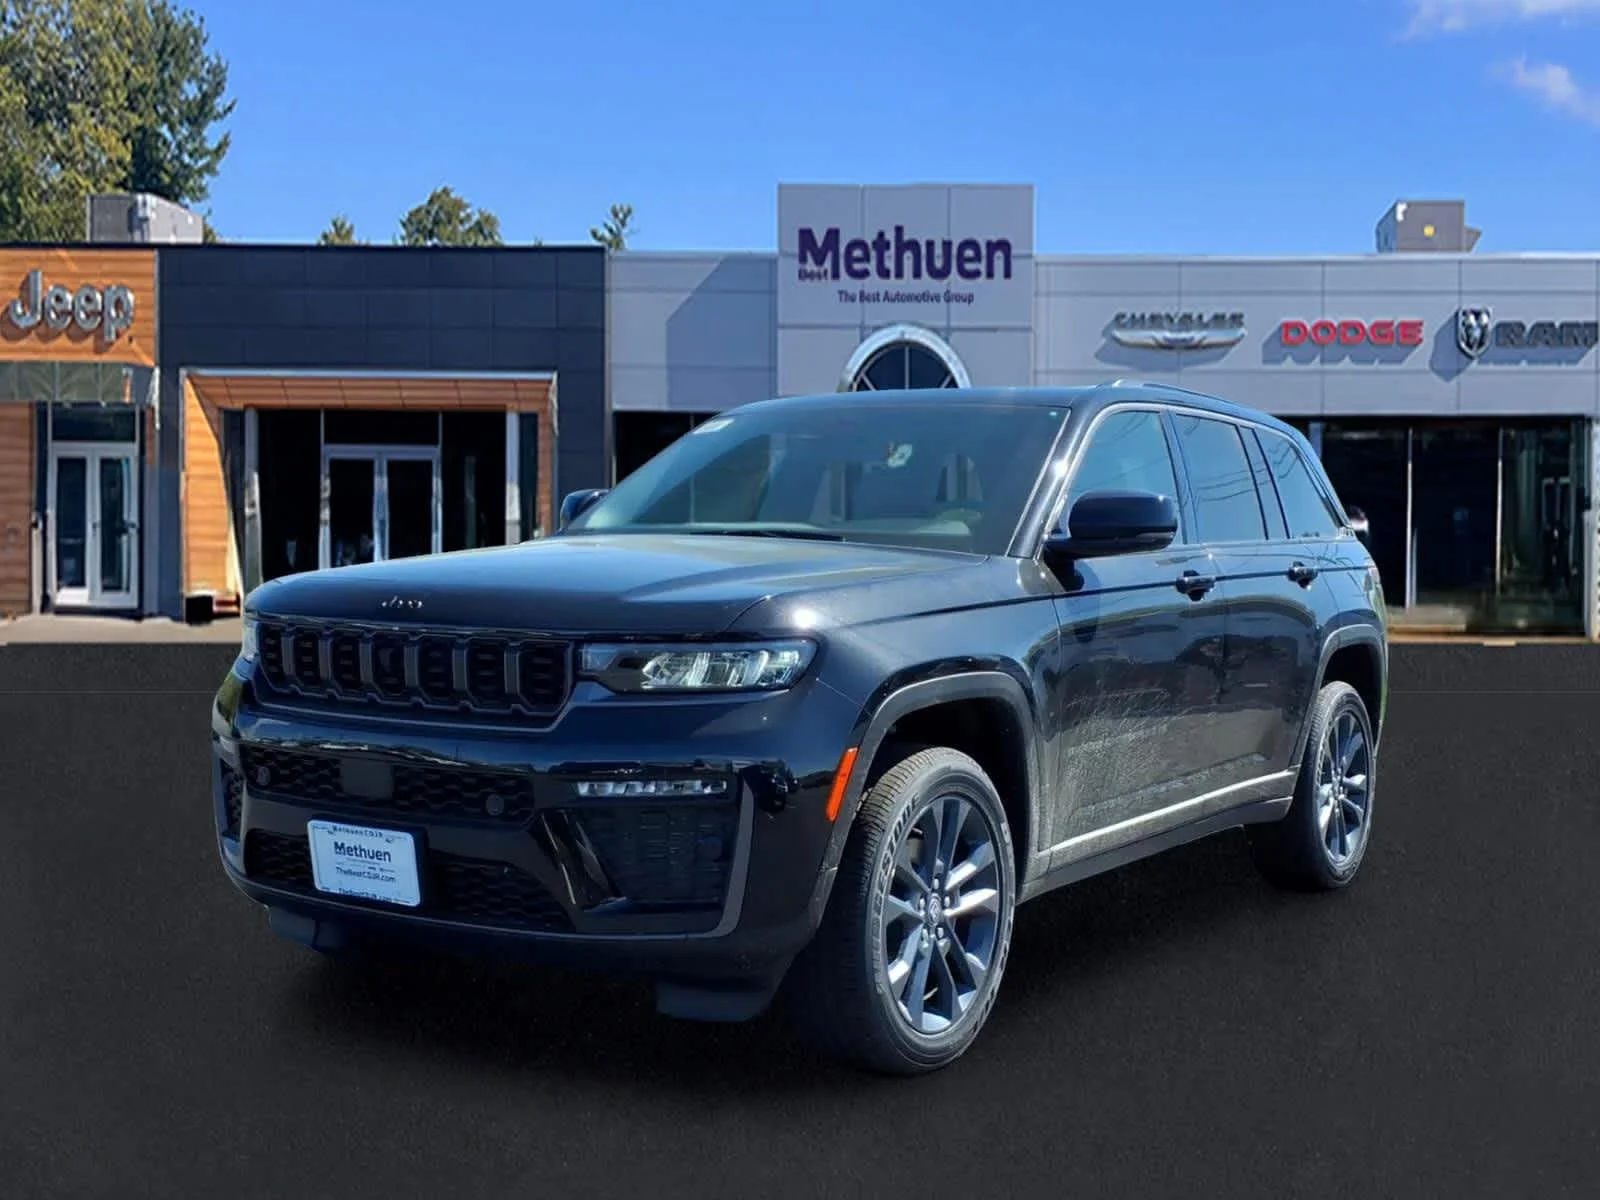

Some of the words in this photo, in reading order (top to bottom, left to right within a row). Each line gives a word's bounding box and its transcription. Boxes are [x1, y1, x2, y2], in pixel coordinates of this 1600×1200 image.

[798, 225, 1012, 280] Methuen
[9, 269, 135, 341] Jeep
[838, 289, 857, 303] The
[859, 289, 881, 303] Best
[883, 289, 941, 303] Automotive
[943, 289, 974, 305] Group
[1281, 319, 1423, 345] DODGE
[1495, 321, 1599, 348] RAM
[334, 841, 391, 862] Methuen
